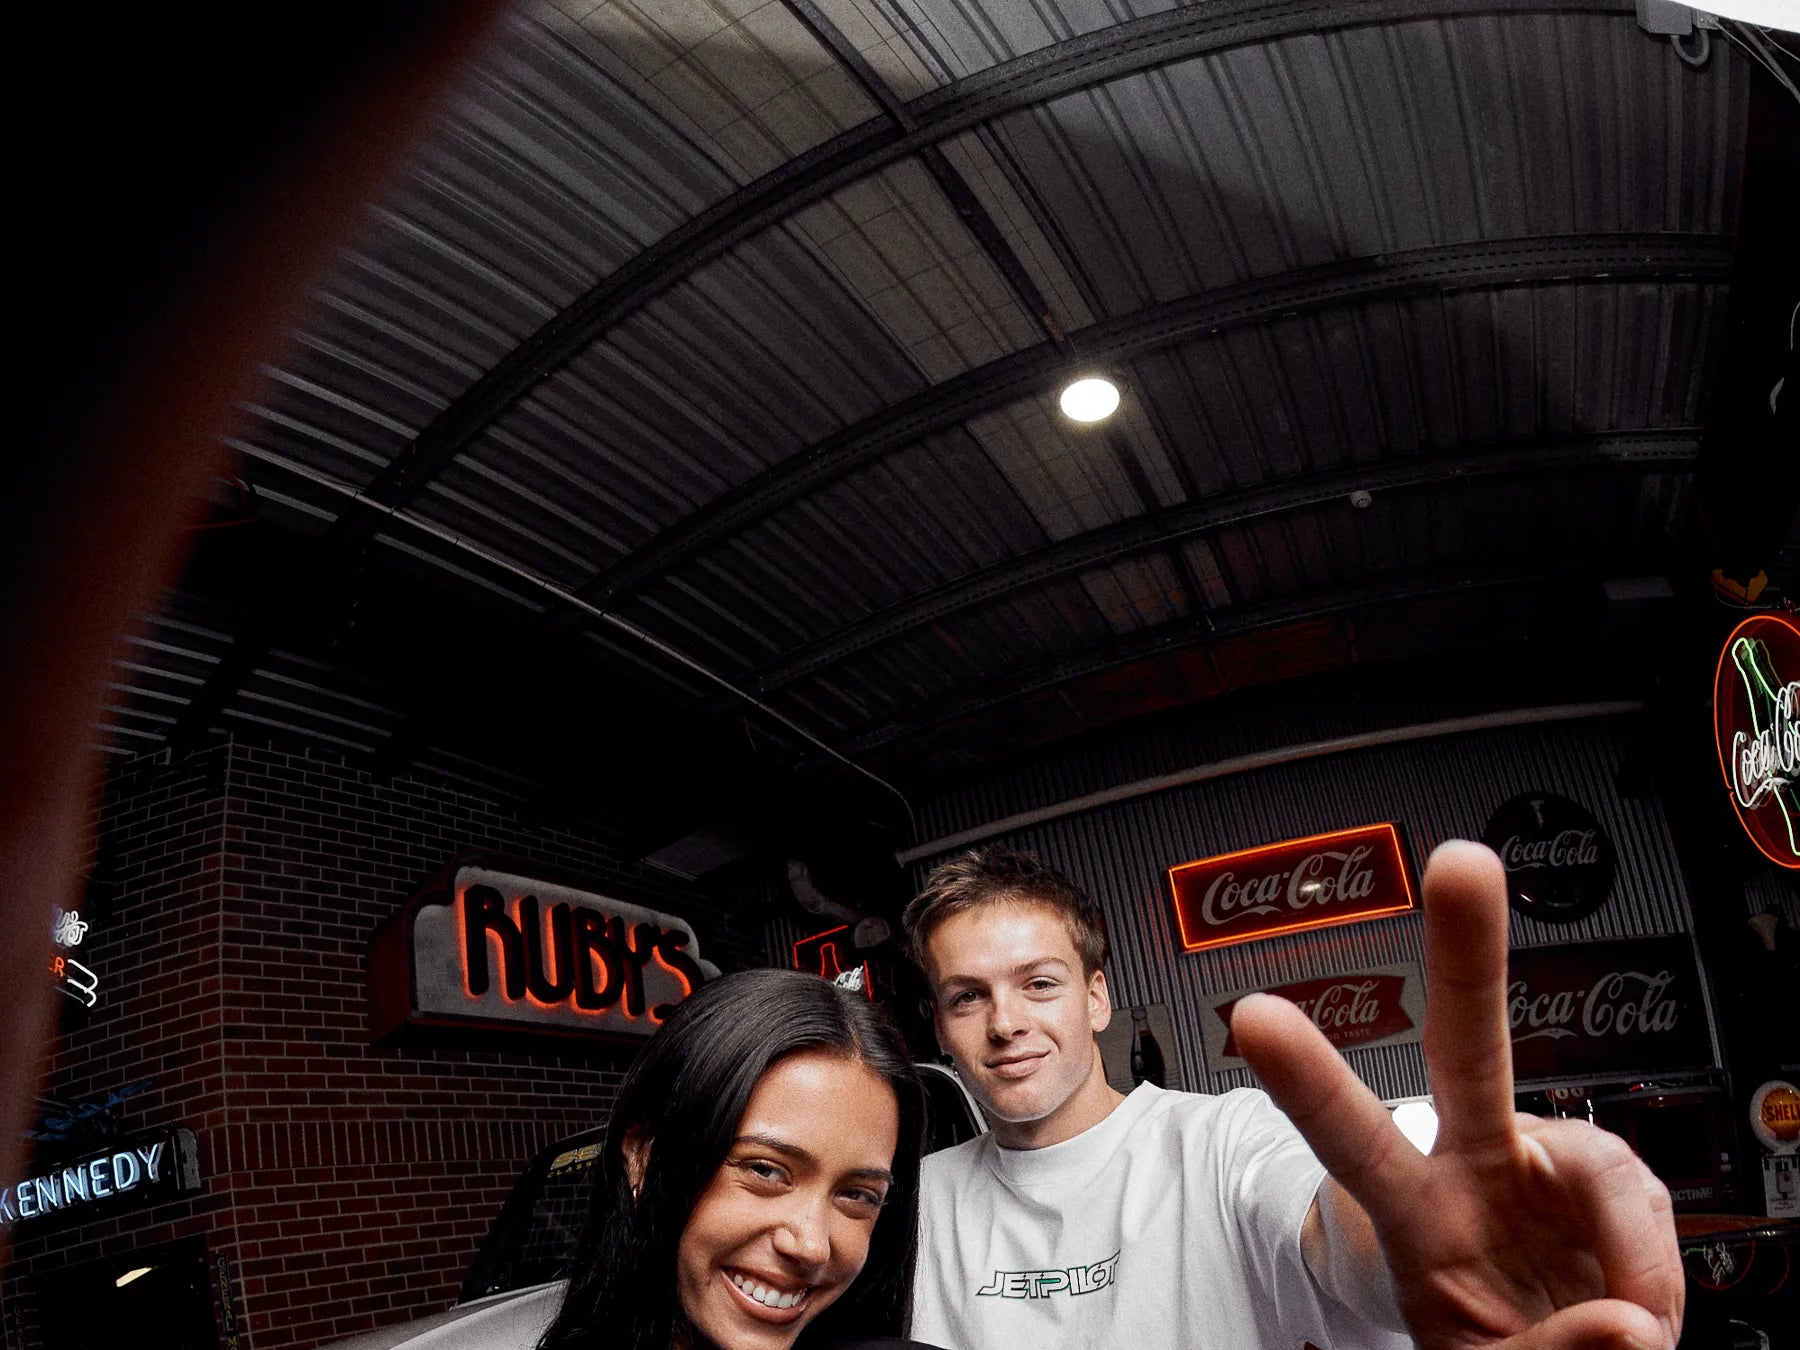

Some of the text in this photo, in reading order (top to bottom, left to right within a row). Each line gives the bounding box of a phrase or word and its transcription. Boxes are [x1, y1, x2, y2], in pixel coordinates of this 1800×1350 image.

[1500, 829, 1599, 873] Coca-Cola
[1202, 845, 1375, 925] Coca-Cola
[975, 1248, 1121, 1300] JETPILOT
